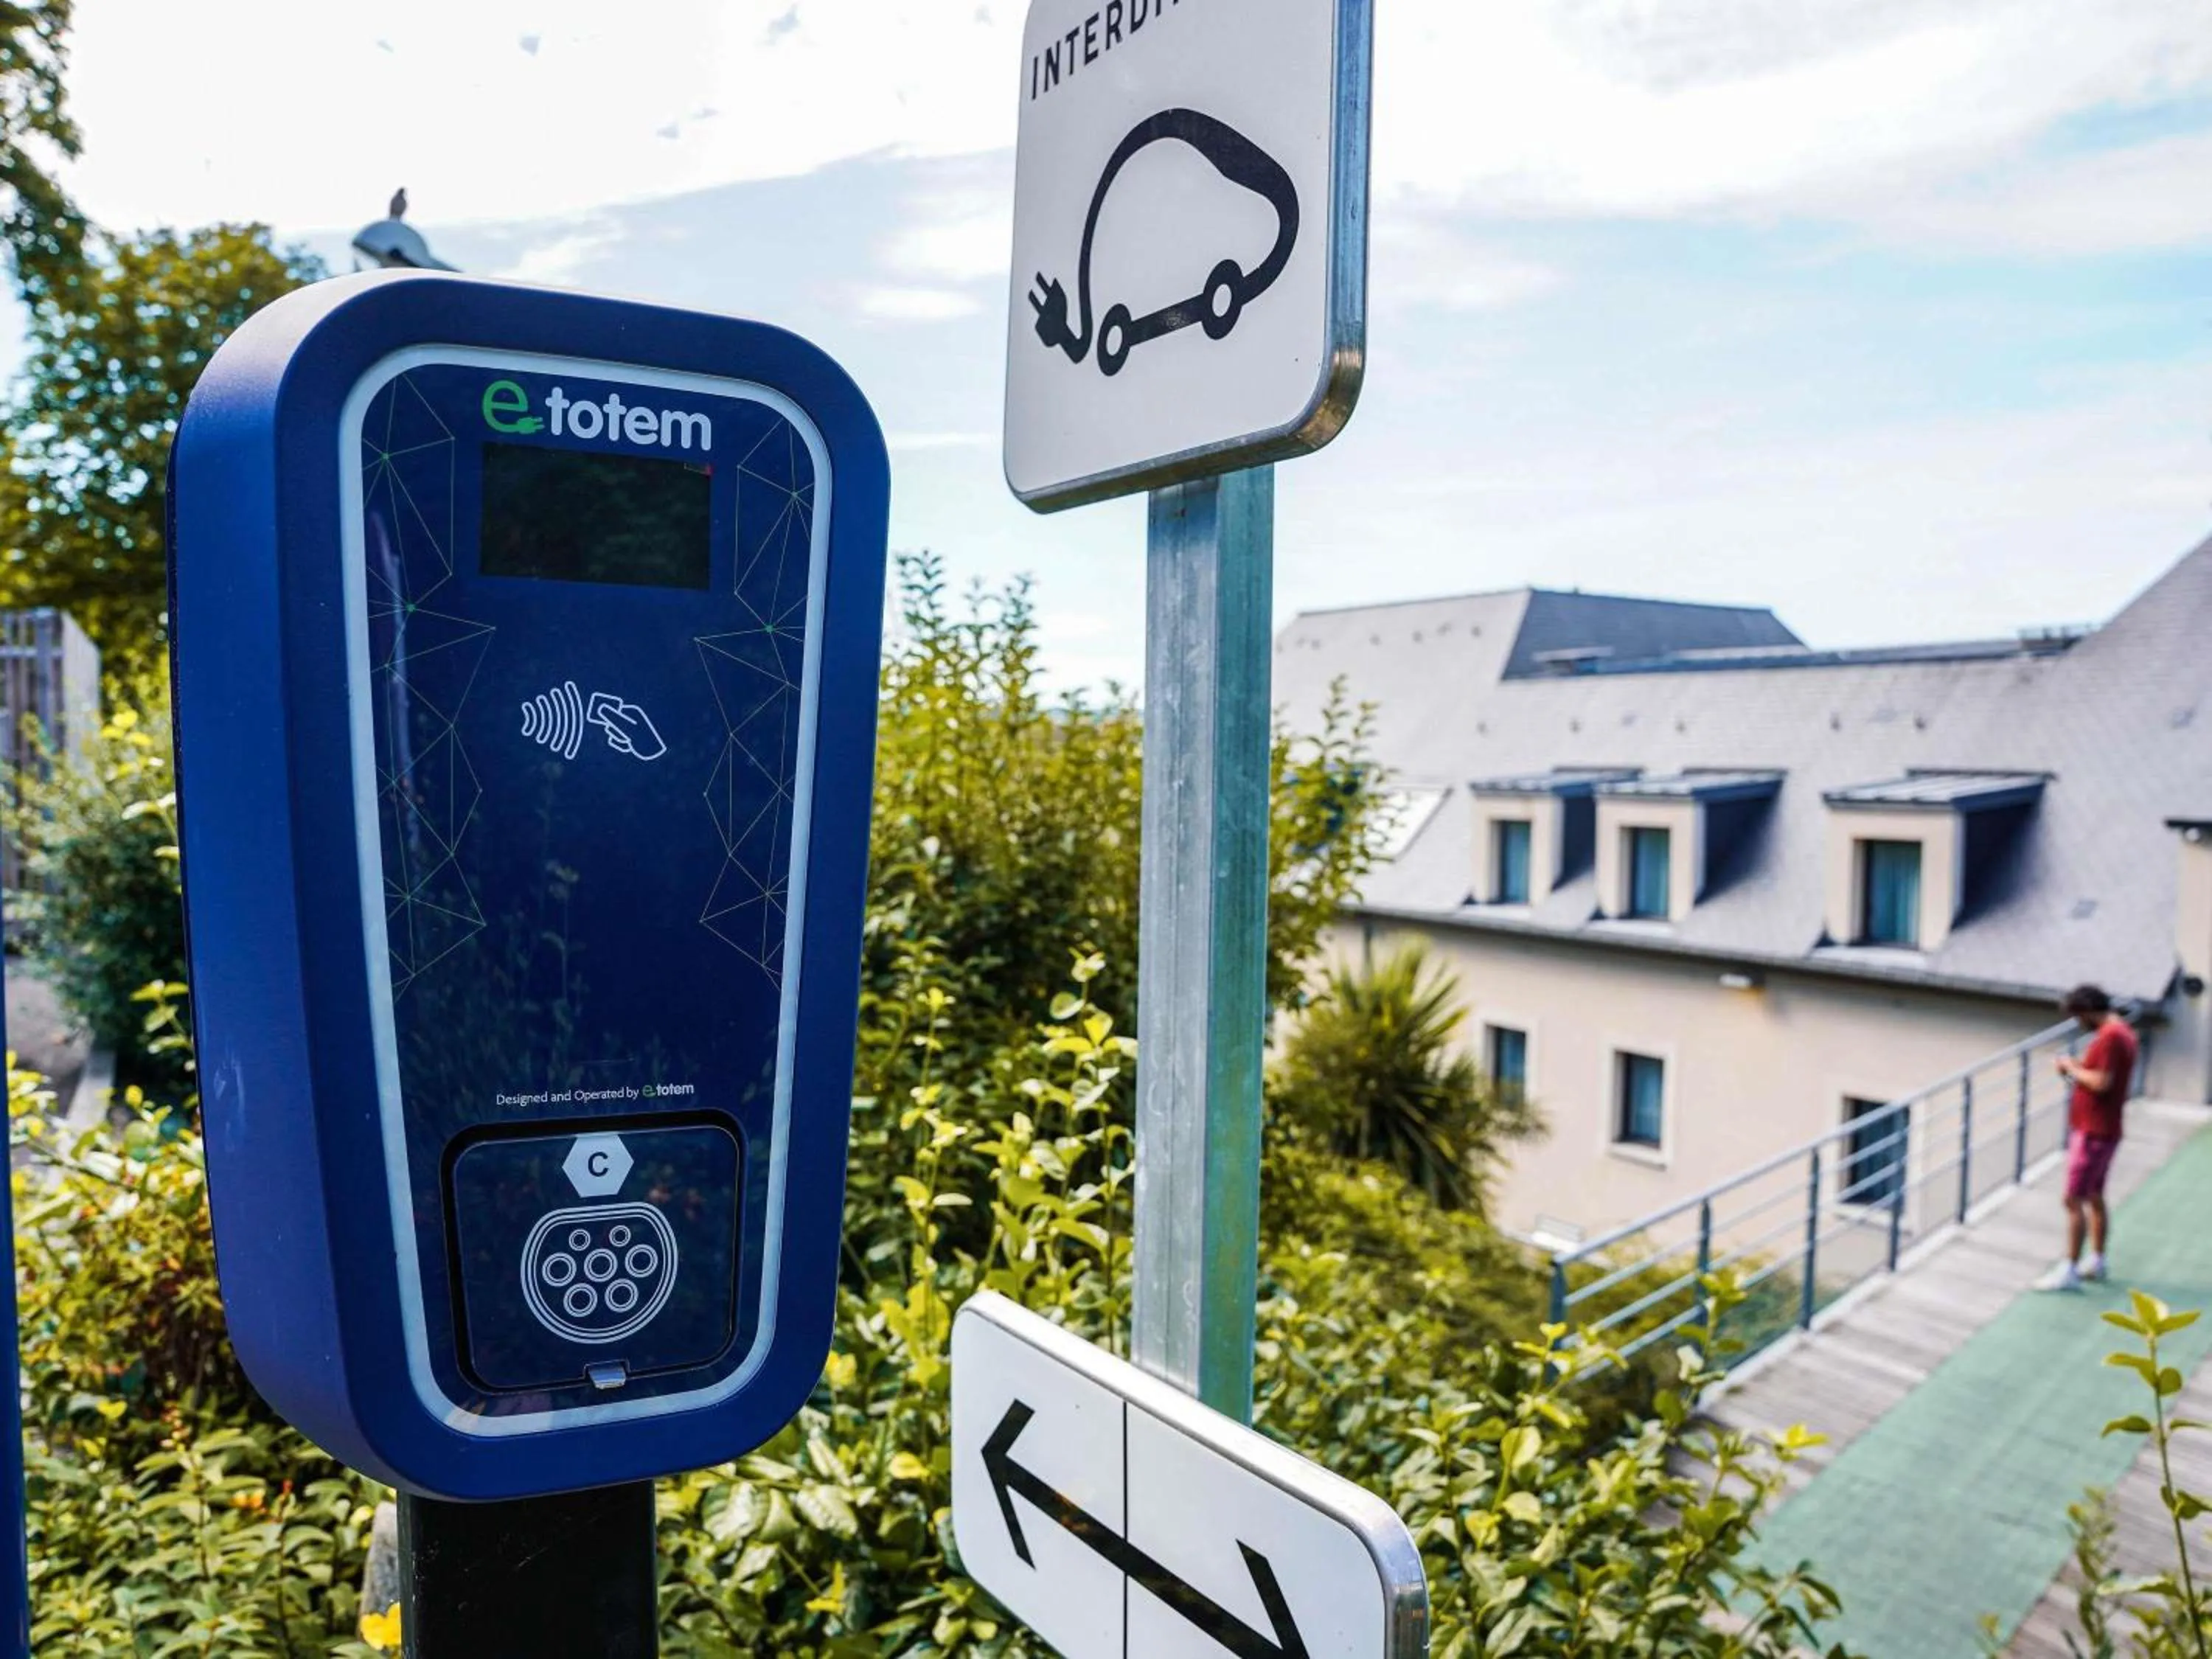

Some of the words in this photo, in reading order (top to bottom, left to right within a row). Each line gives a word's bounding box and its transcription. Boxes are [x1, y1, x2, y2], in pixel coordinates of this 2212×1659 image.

[1032, 0, 1180, 100] INTERD
[545, 386, 712, 451] totem
[496, 1092, 548, 1106] Designed
[551, 1088, 571, 1102] and
[574, 1088, 625, 1103] Operated
[627, 1086, 639, 1099] by
[656, 1083, 695, 1096] totem
[588, 1152, 608, 1177] C
